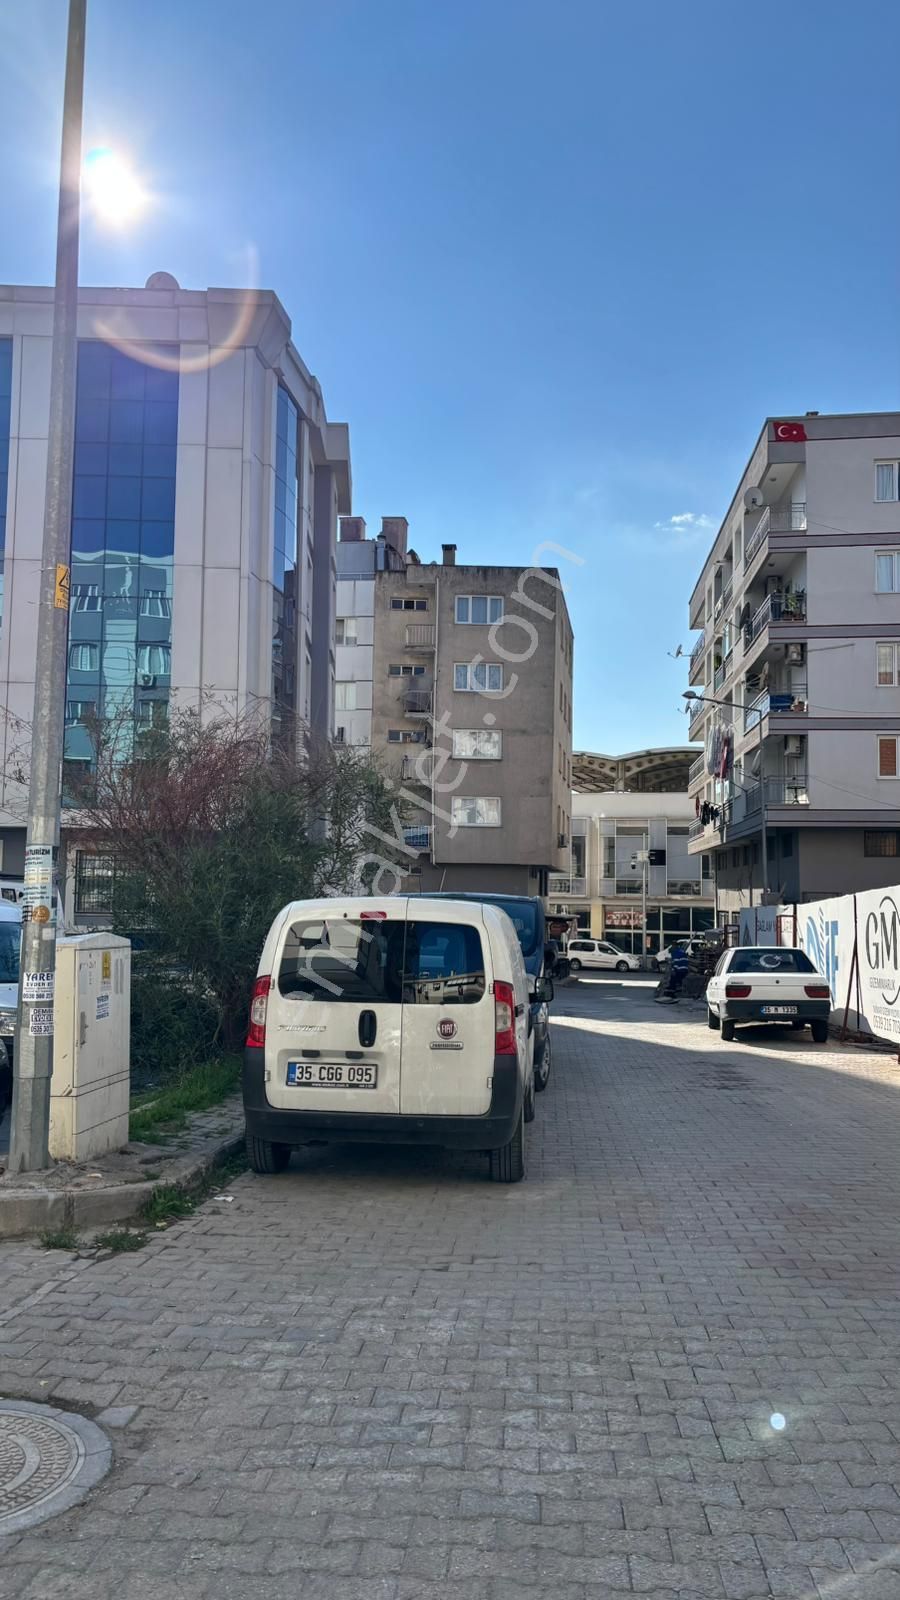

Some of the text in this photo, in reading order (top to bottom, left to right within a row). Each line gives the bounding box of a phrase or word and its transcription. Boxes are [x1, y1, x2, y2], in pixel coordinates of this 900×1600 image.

[441, 1024, 453, 1034] FIAT
[296, 1065, 313, 1081] 35
[318, 1066, 343, 1081] CGG
[347, 1067, 373, 1083] 095
